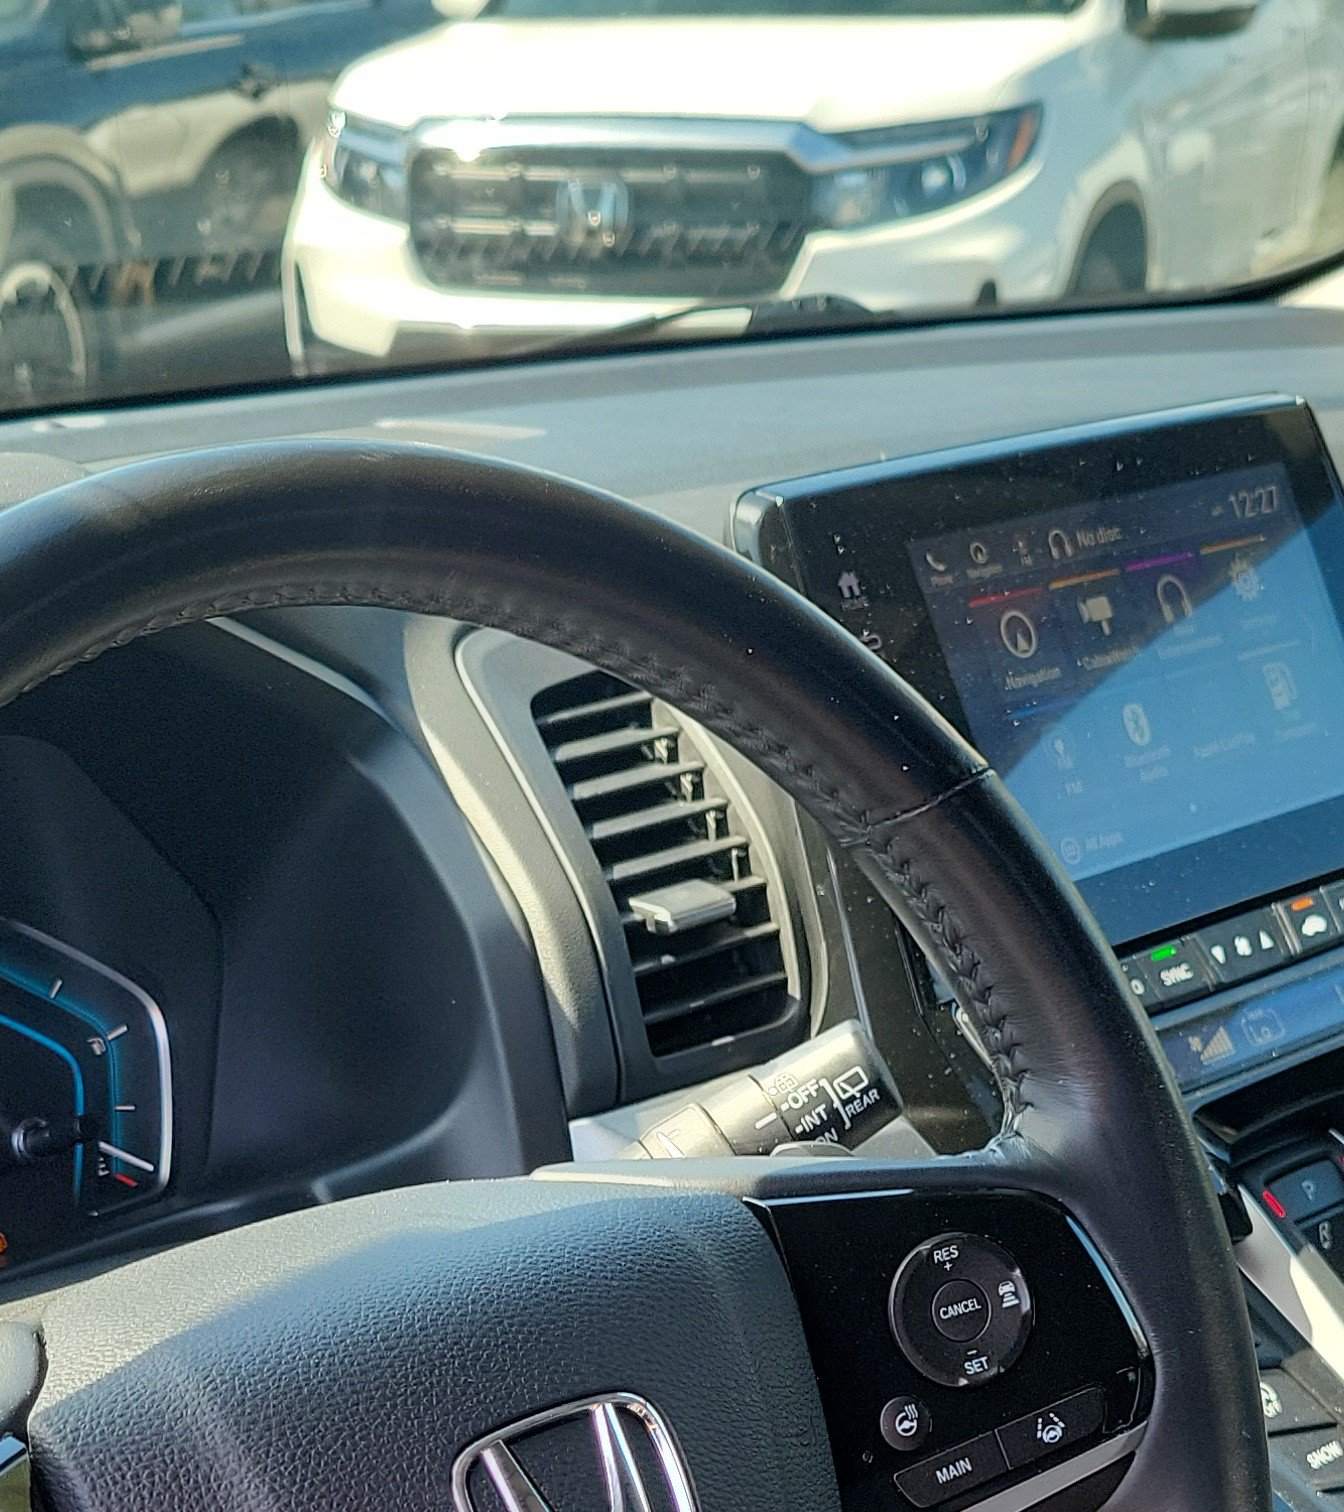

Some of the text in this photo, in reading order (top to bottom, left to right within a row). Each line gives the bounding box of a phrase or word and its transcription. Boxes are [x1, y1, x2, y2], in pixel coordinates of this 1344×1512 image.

[1228, 485, 1278, 519] 12:27
[1075, 530, 1095, 549] No
[1007, 667, 1061, 691] Navigation
[1159, 963, 1195, 987] SYNC
[787, 1078, 821, 1111] OFF
[844, 1088, 881, 1118] REAR
[800, 1104, 828, 1134] INT
[933, 1244, 959, 1264] RES
[939, 1297, 982, 1320] CANCEL
[964, 1355, 989, 1376] SET
[1305, 1440, 1344, 1471] SNOW
[936, 1456, 973, 1485] MAIN
